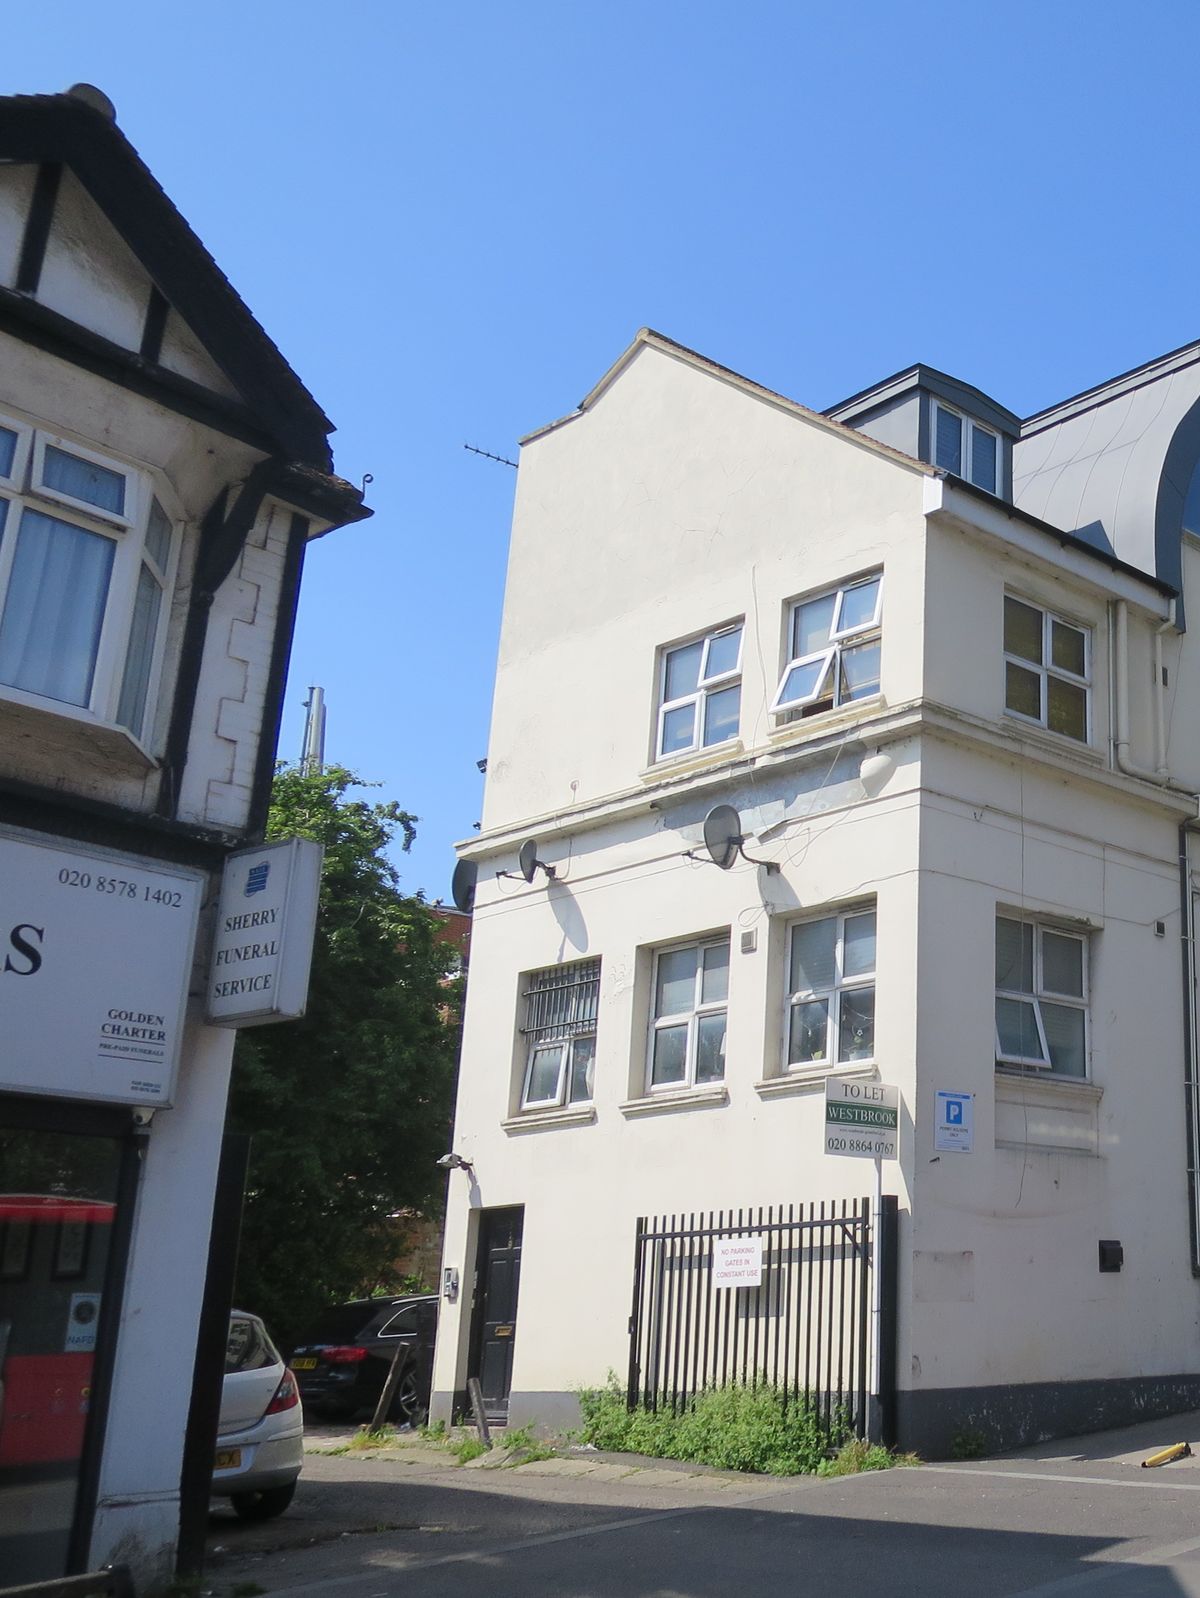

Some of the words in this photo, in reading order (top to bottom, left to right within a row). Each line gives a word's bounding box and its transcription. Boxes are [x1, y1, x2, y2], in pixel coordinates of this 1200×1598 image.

[58, 867, 92, 888] 020
[96, 876, 138, 898] 8578
[143, 886, 182, 909] 1402
[224, 907, 279, 933] SHERRY
[0, 923, 45, 976] S
[215, 941, 278, 967] FUNERAL
[214, 974, 272, 999] SERVICE
[107, 1008, 165, 1026] GOLDEN
[101, 1023, 166, 1041] CHARTER
[841, 1083, 860, 1099] TO
[864, 1087, 886, 1102] LET
[828, 1106, 896, 1126] WESTBROOK
[828, 1137, 846, 1151] 020
[849, 1139, 873, 1153] 8864
[875, 1142, 894, 1155] 0767
[721, 1248, 730, 1256] NO
[730, 1247, 755, 1255] PARKING
[716, 1270, 745, 1278] CONSTANT
